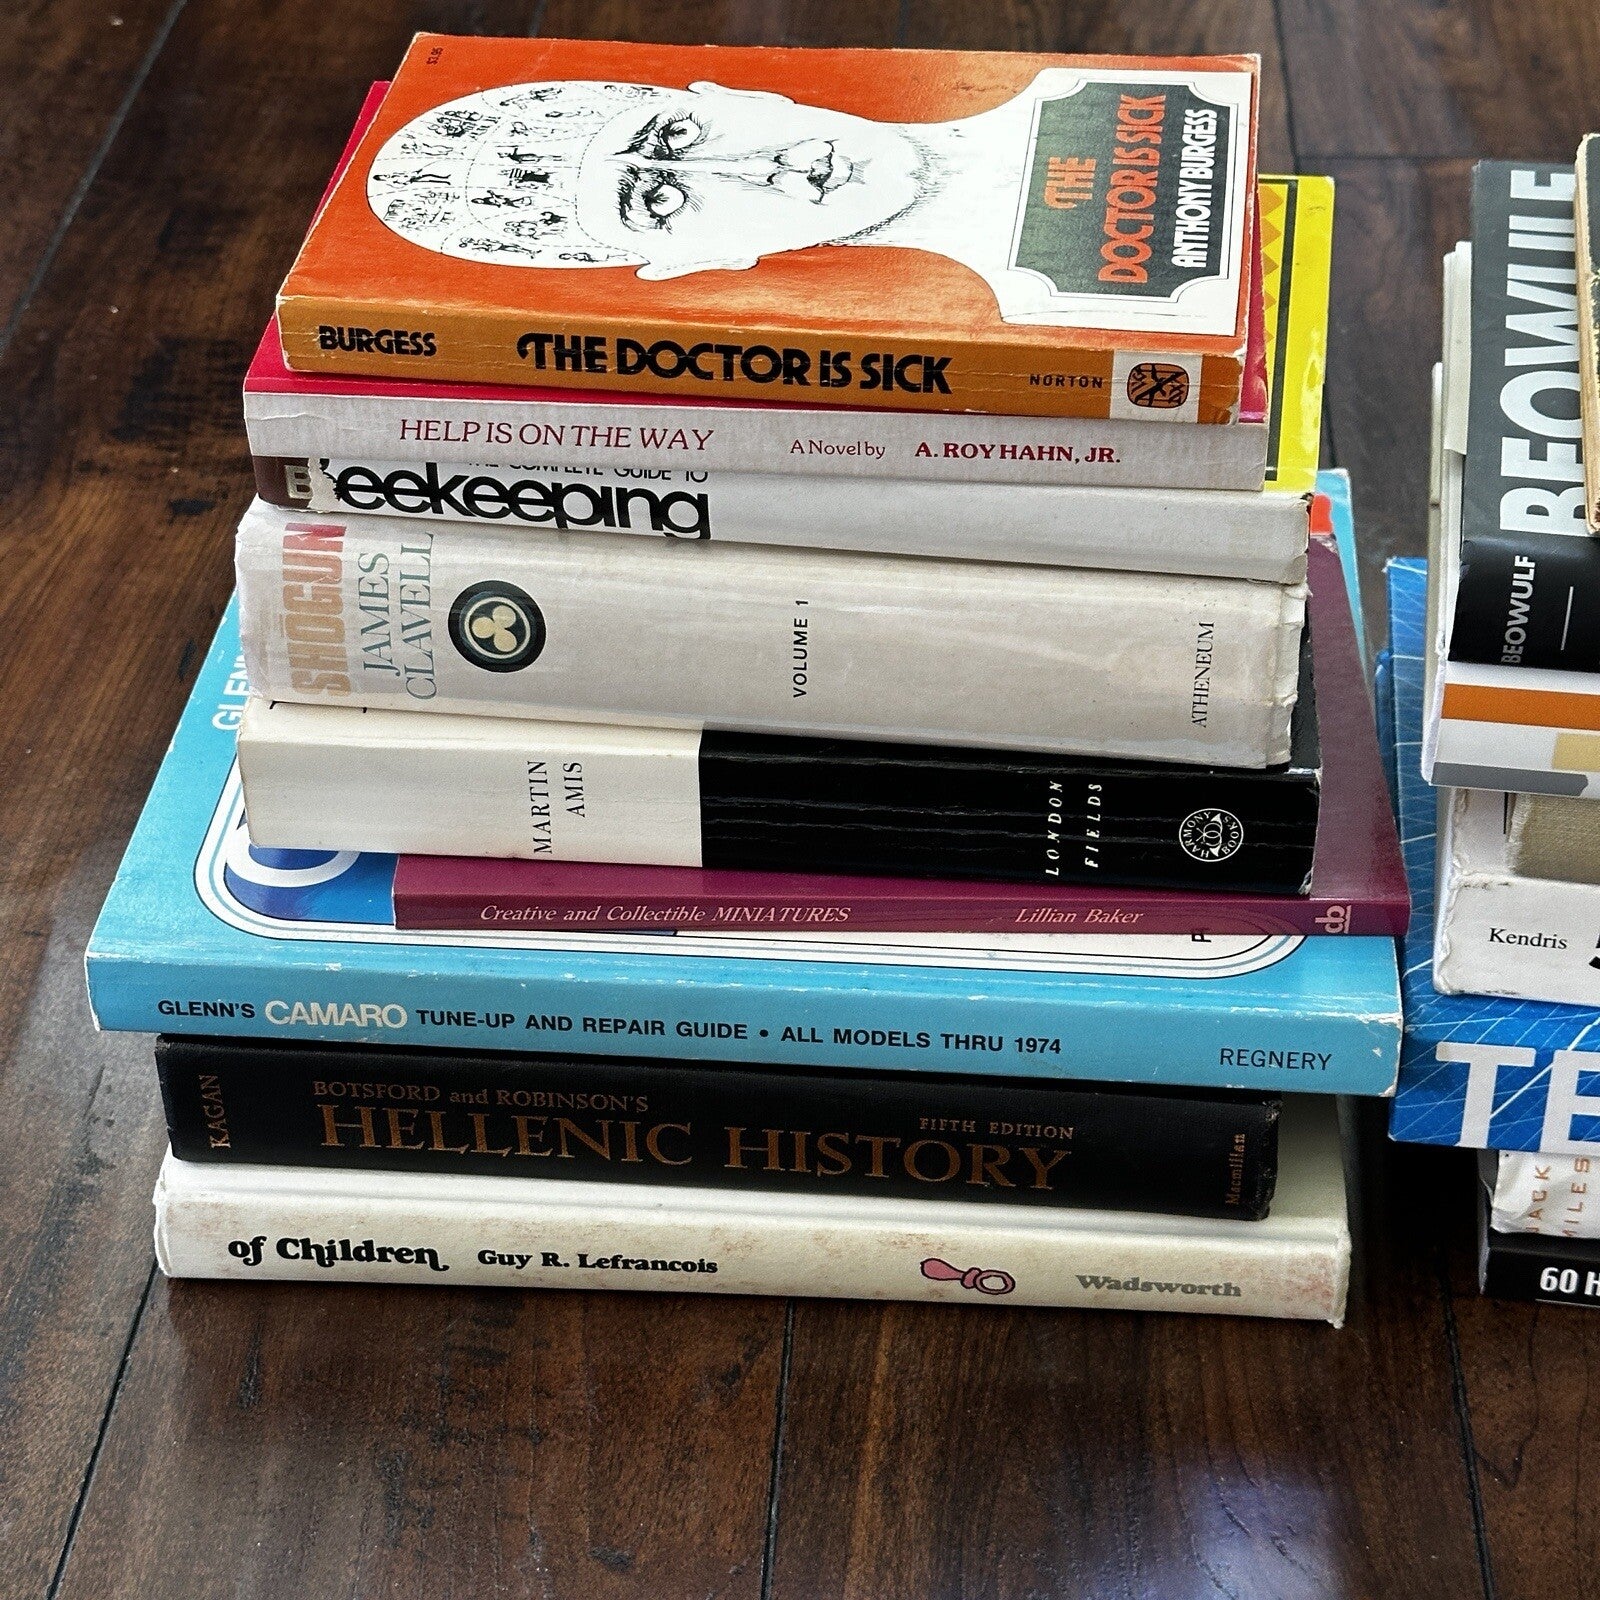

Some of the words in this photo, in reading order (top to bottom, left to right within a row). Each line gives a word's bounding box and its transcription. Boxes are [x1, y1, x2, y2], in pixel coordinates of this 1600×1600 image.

[1115, 94, 1166, 144] SICK
[1179, 108, 1218, 179] BURGESS
[1044, 157, 1096, 210] THE
[1112, 147, 1160, 166] IS
[1098, 169, 1159, 284] DOCTOR
[1171, 179, 1212, 268] ANTHONY
[319, 325, 437, 357] BURGESS
[517, 332, 608, 374] THE
[616, 338, 811, 386] DOCTOR
[820, 350, 852, 387] IS
[860, 353, 953, 394] SICK
[1029, 373, 1103, 389] NORTON
[400, 419, 481, 442] HELP
[486, 422, 512, 444] IS
[519, 424, 566, 446] ON
[571, 425, 632, 448] THE
[639, 427, 714, 451] WAY
[790, 439, 806, 454] A
[808, 440, 862, 456] Novel
[865, 442, 886, 460] by
[915, 442, 938, 458] A.
[943, 443, 999, 459] ROY
[999, 444, 1080, 464] HAHN,
[1084, 447, 1121, 463] JR.
[319, 458, 711, 540] eekeeping
[358, 552, 400, 677] JAMES
[400, 532, 437, 700] CLAVELL
[1502, 555, 1535, 663] BEOWULF
[792, 618, 808, 698] VOLUME
[1191, 621, 1215, 728] ATHENEUM
[527, 761, 552, 854] MARTIN
[562, 762, 585, 818] AMIS
[1045, 781, 1063, 876] LONDON
[1085, 783, 1102, 868] FIELDS
[1183, 811, 1211, 858] HARMONY
[1221, 815, 1240, 855] BOOKS
[480, 905, 556, 921] Creative
[563, 906, 600, 922] and
[606, 906, 705, 922] Collectible
[711, 906, 851, 923] MINIATURES
[1015, 908, 1077, 923] Lillian
[1083, 909, 1143, 924] Baker
[1488, 927, 1568, 950] Kendris
[158, 999, 256, 1019] GLENN'S
[265, 1000, 408, 1028] CAMARO
[416, 1009, 516, 1029] TUNE-UP
[525, 1014, 573, 1032] AND
[582, 1017, 666, 1036] REPAIR
[676, 1021, 748, 1040] GUIDE
[780, 1026, 824, 1044] ALL
[833, 1028, 931, 1049] MODELS
[940, 1033, 1004, 1052] THRU
[1013, 1036, 1062, 1055] 1974
[1220, 1047, 1332, 1072] REGNERY
[199, 1074, 231, 1148] KAGAN
[313, 1081, 440, 1102] BOTSFORD
[449, 1088, 489, 1106] and
[497, 1089, 649, 1113] ROBINSON'S
[317, 1104, 693, 1167] HELLENIC
[724, 1126, 1072, 1190] HISTORY
[920, 1117, 976, 1133] FIFTH
[990, 1121, 1075, 1141] EDITION
[1225, 1133, 1246, 1205] Macmillan
[228, 1237, 267, 1266] of
[276, 1237, 450, 1272] Children
[477, 1249, 533, 1269] Guy
[540, 1252, 570, 1268] R.
[577, 1253, 718, 1274] Lefrancois
[1539, 1266, 1578, 1294] 60
[1075, 1274, 1242, 1298] Wadsworth
